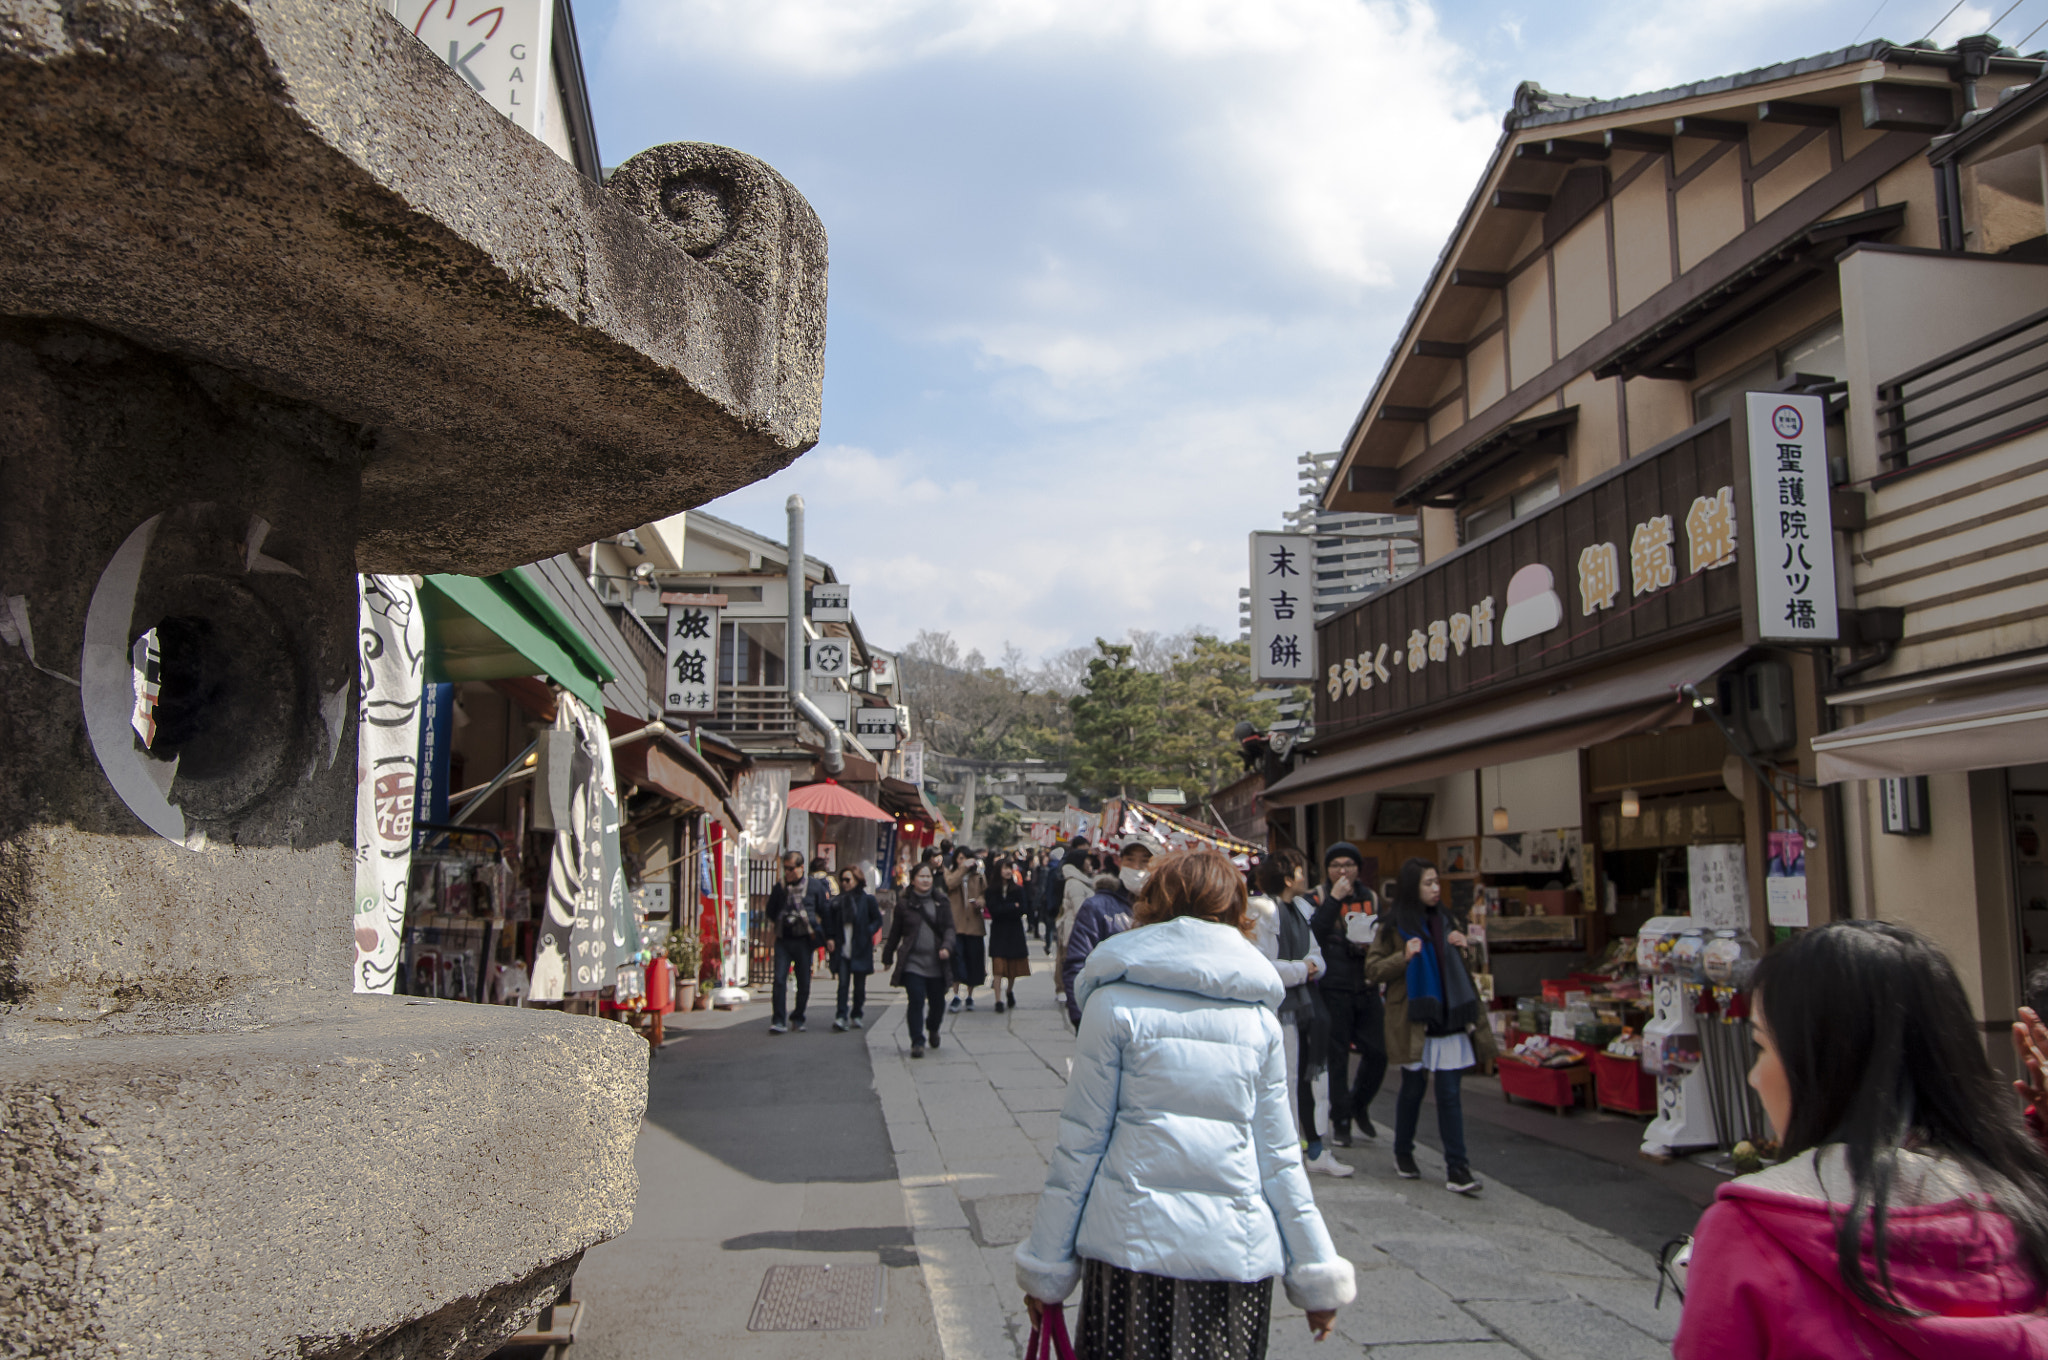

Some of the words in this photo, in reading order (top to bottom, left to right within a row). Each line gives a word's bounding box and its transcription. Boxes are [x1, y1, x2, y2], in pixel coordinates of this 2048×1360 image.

[1578, 485, 1739, 617] 御鏡餅
[1776, 442, 1816, 629] 聖護院八ツ橋
[673, 607, 711, 684] 旅館
[1267, 544, 1301, 668] 末吉餅
[669, 691, 709, 708] 田中亭
[376, 776, 415, 836] 福
